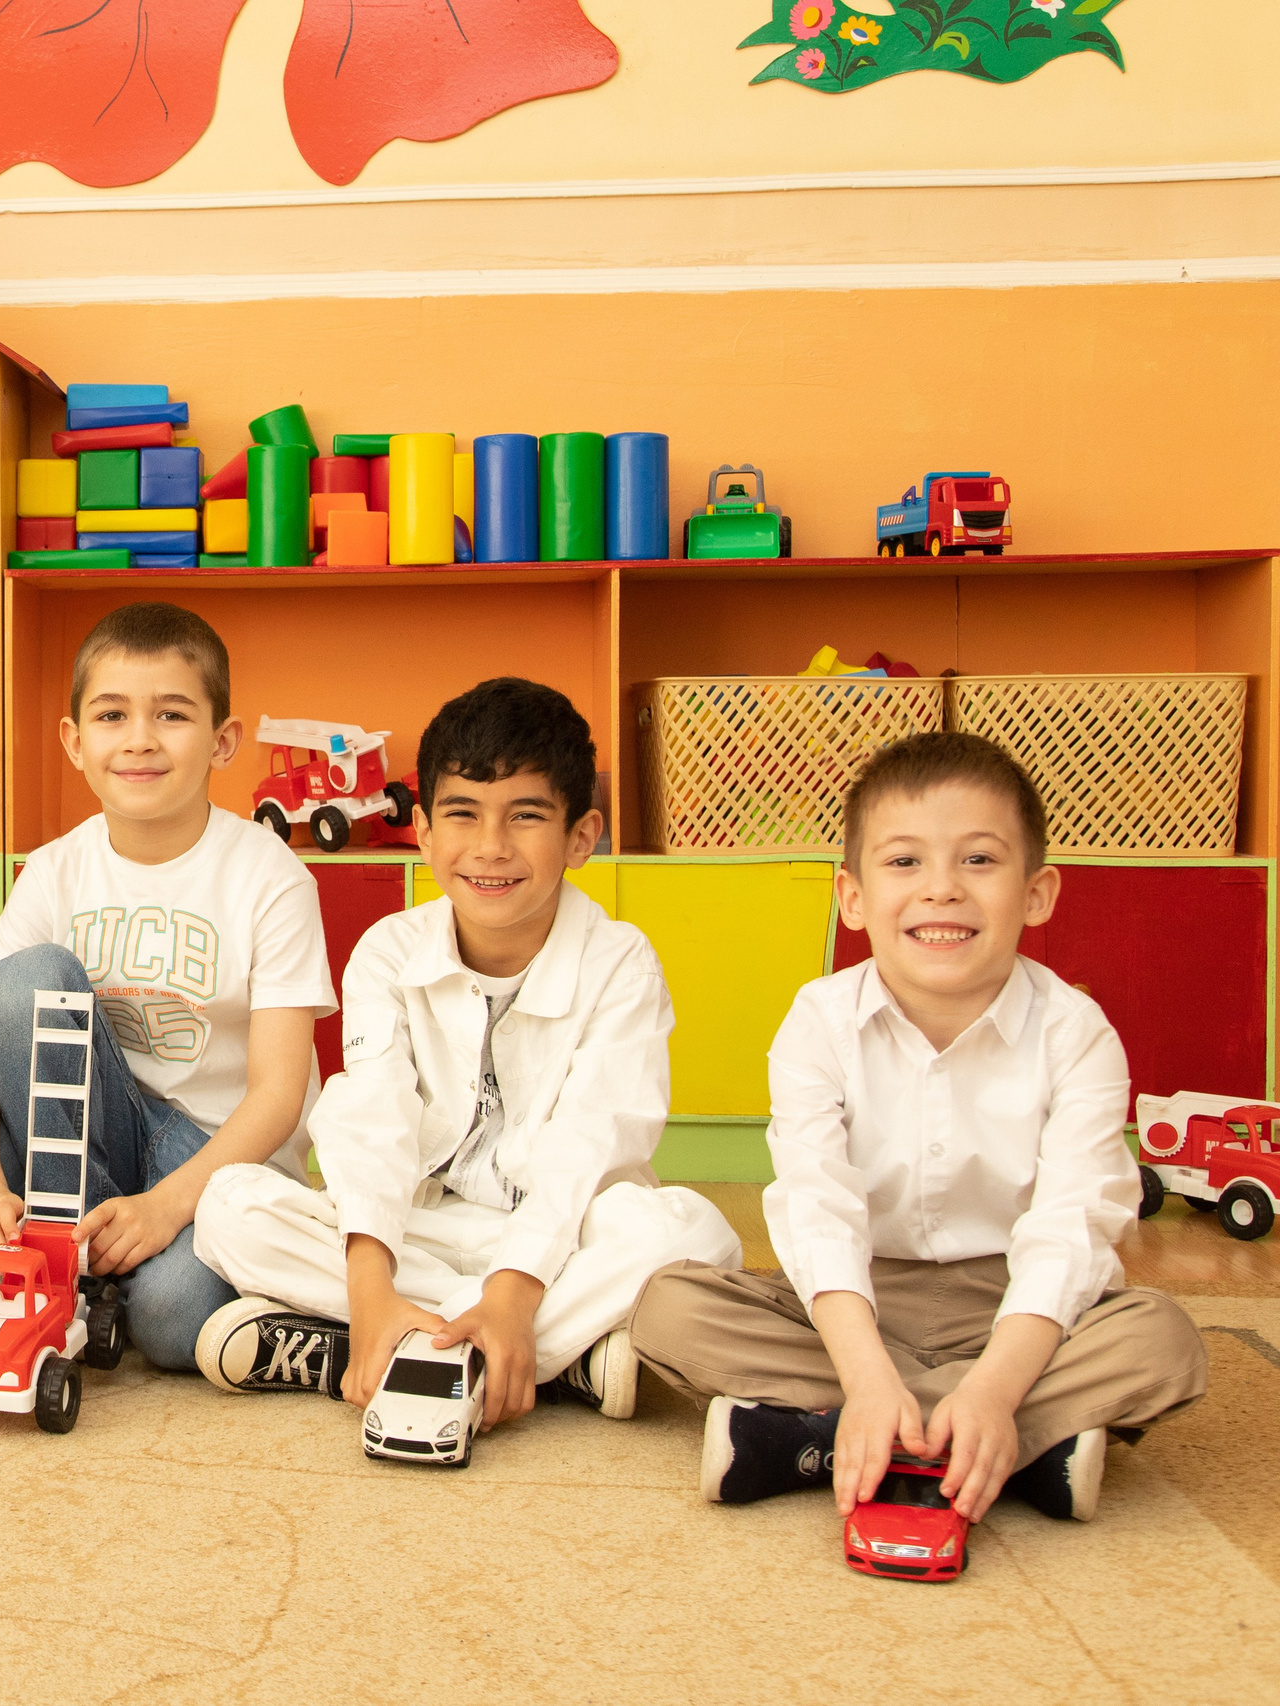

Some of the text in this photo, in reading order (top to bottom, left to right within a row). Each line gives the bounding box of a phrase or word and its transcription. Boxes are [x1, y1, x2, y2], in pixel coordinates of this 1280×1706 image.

[71, 906, 219, 1000] UCB
[107, 987, 140, 997] COLORS
[144, 988, 155, 996] OF
